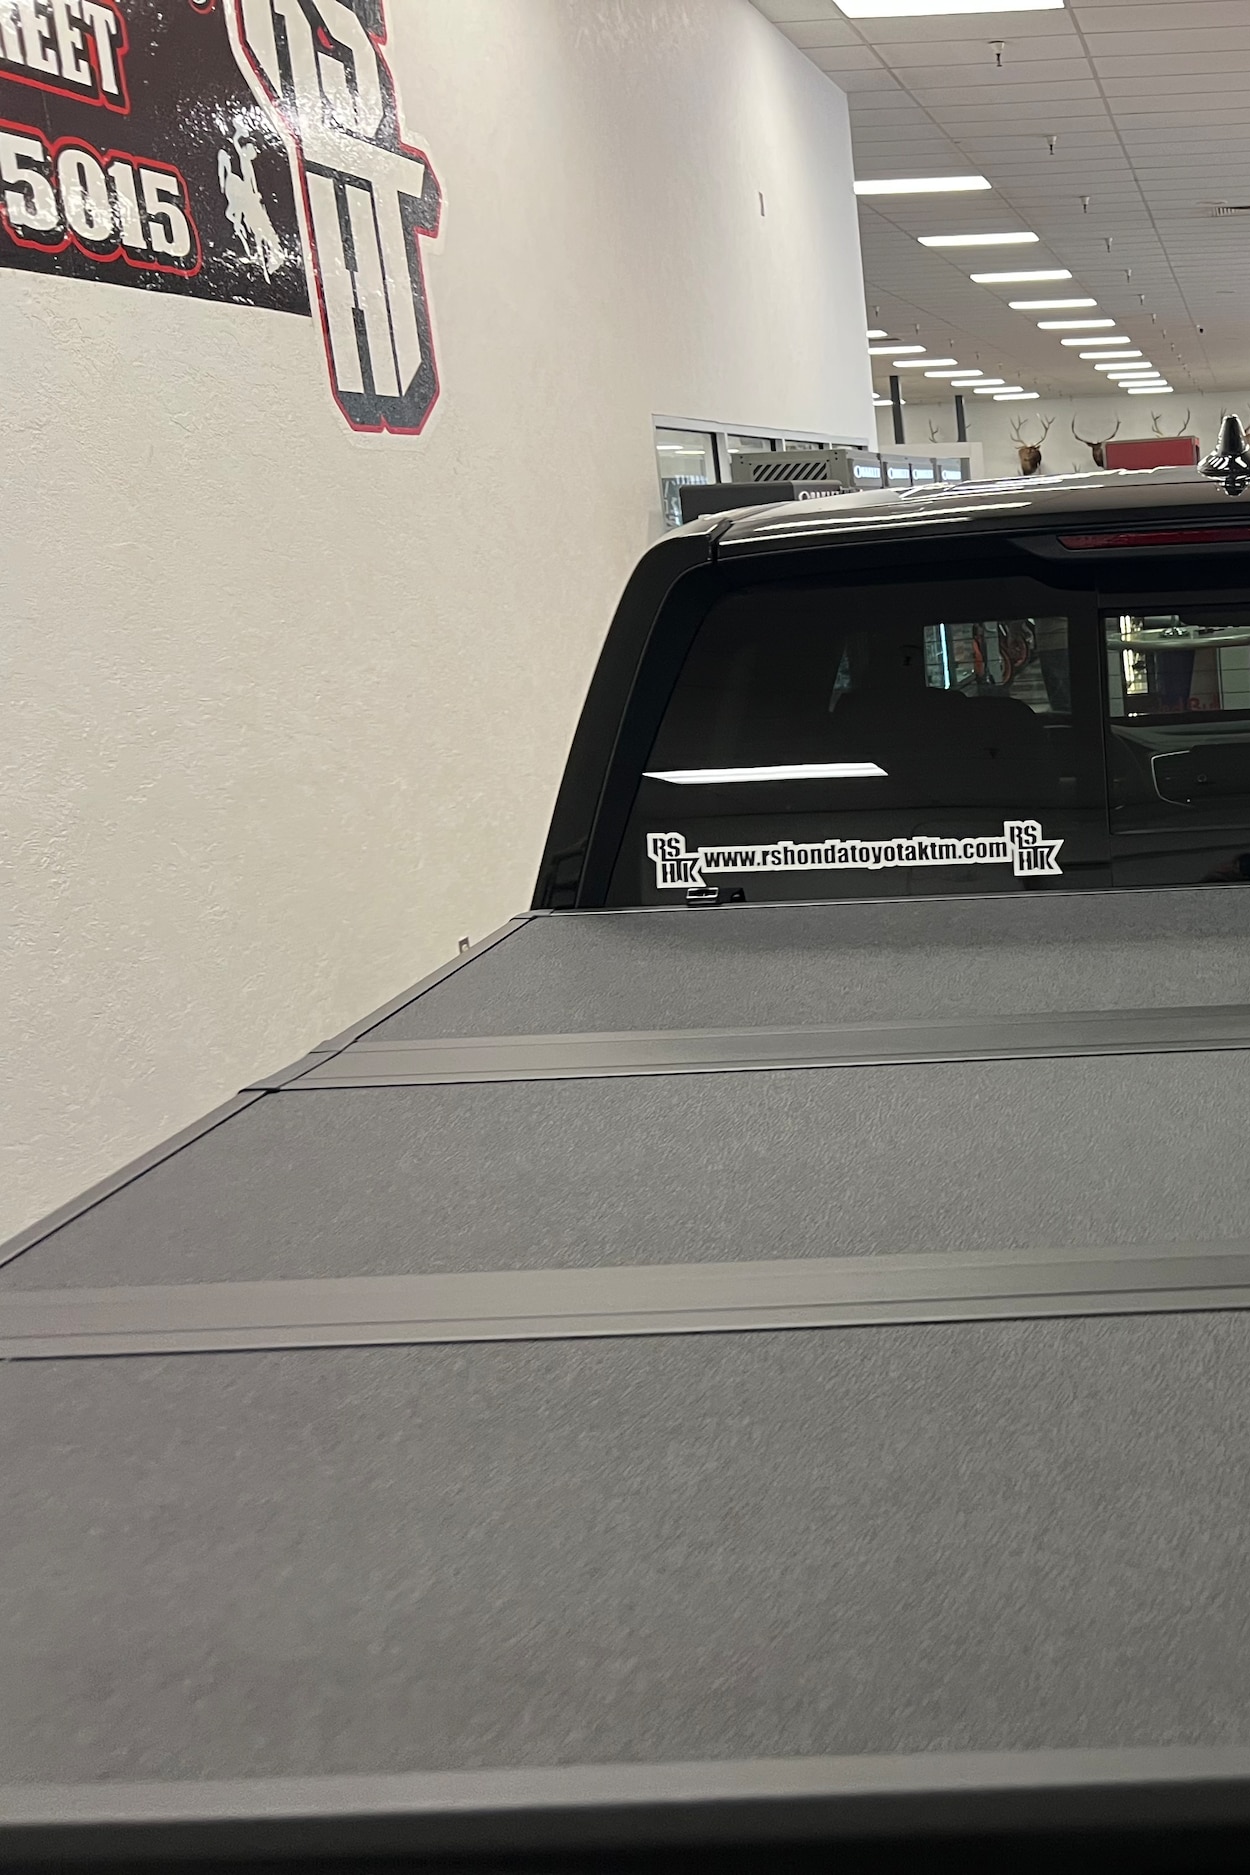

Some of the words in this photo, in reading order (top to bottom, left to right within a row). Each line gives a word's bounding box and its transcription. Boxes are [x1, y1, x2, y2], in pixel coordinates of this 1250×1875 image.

[1, 131, 191, 258] 5015
[652, 837, 681, 859] RS
[1009, 825, 1038, 847] RS
[703, 841, 1008, 868] www.rshondatoyotaktm.com
